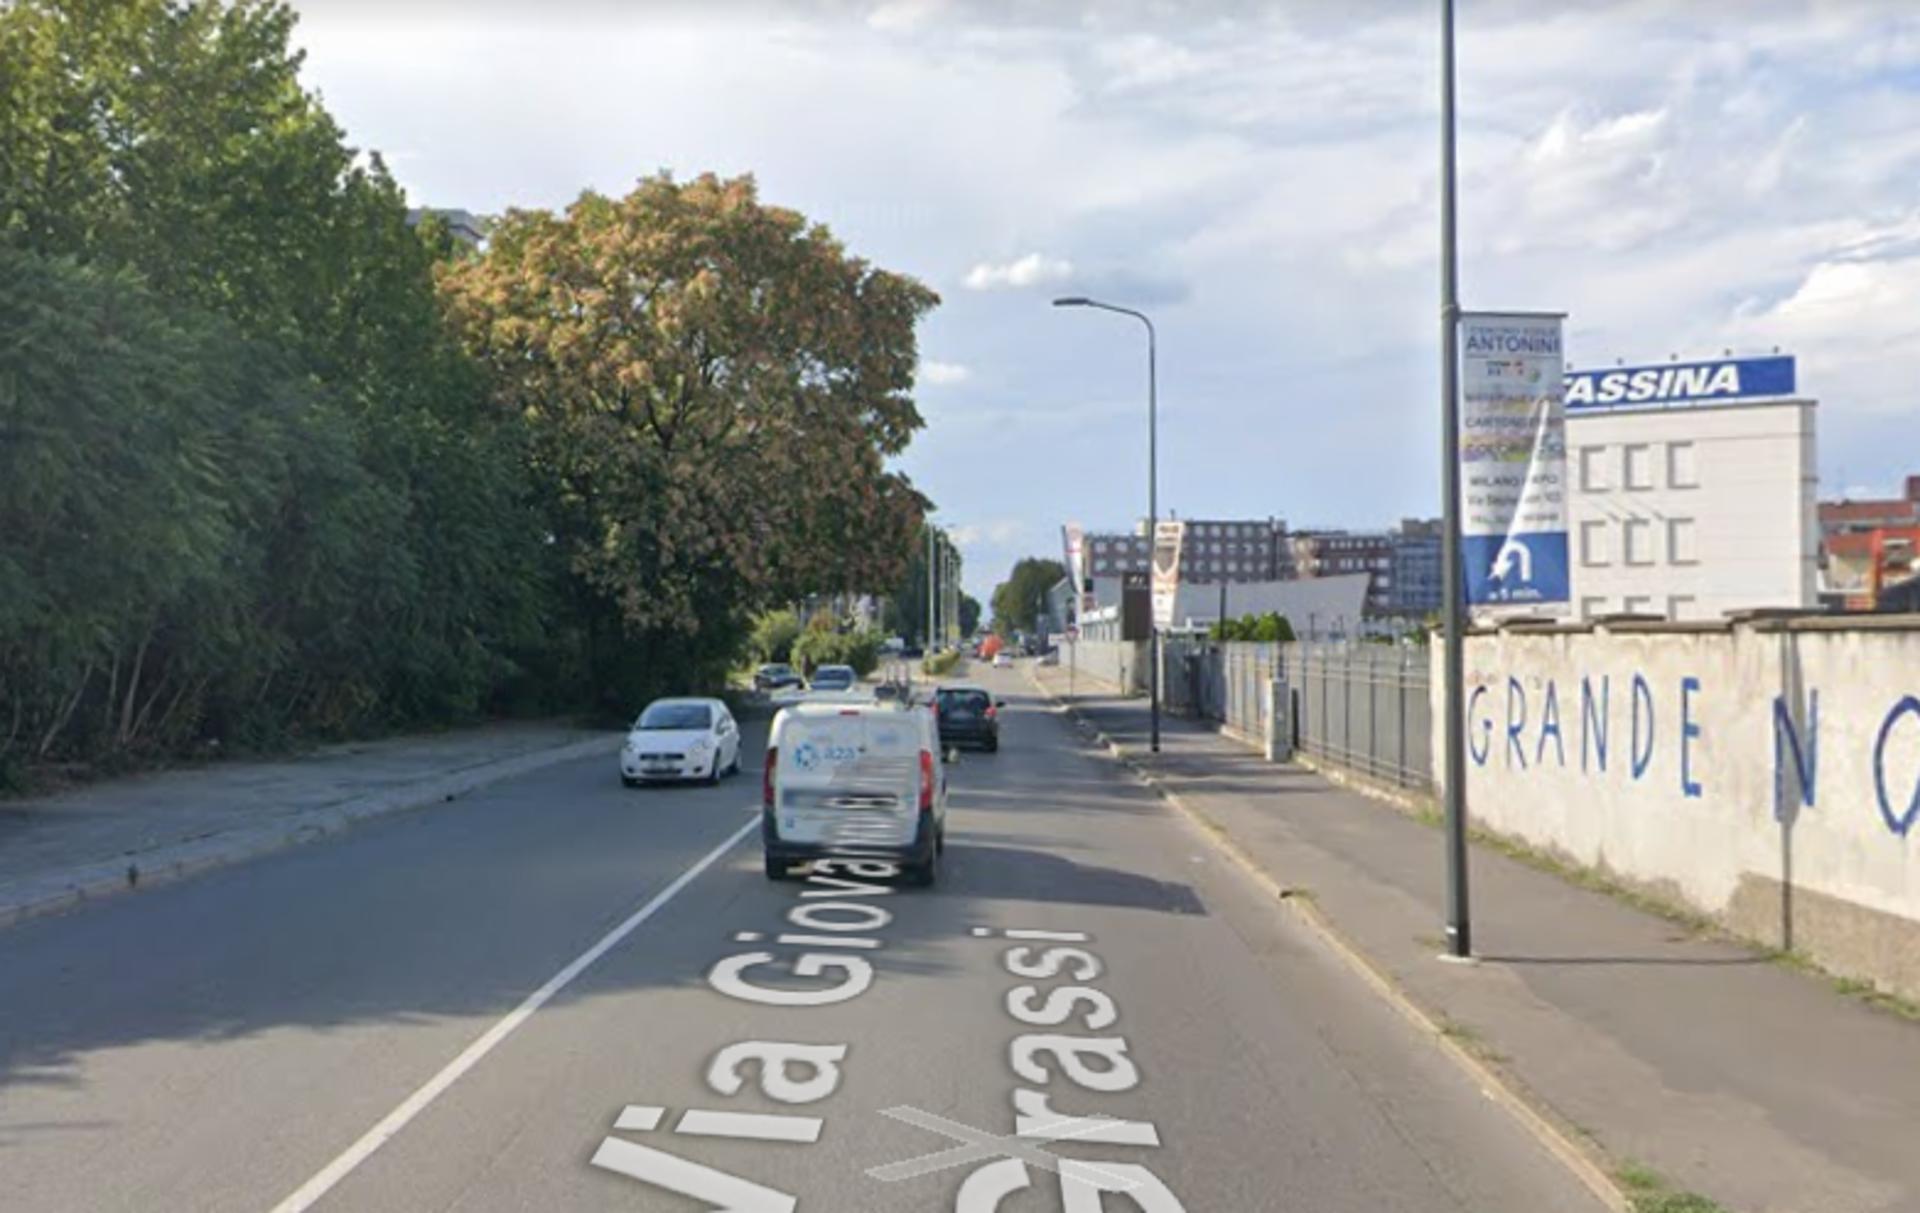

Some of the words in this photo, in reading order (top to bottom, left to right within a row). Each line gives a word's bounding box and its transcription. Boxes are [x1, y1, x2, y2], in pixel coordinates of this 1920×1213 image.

[1465, 335, 1561, 353] ANTONINI
[1563, 363, 1741, 404] ASSINA
[1467, 673, 1702, 798] GRANDE
